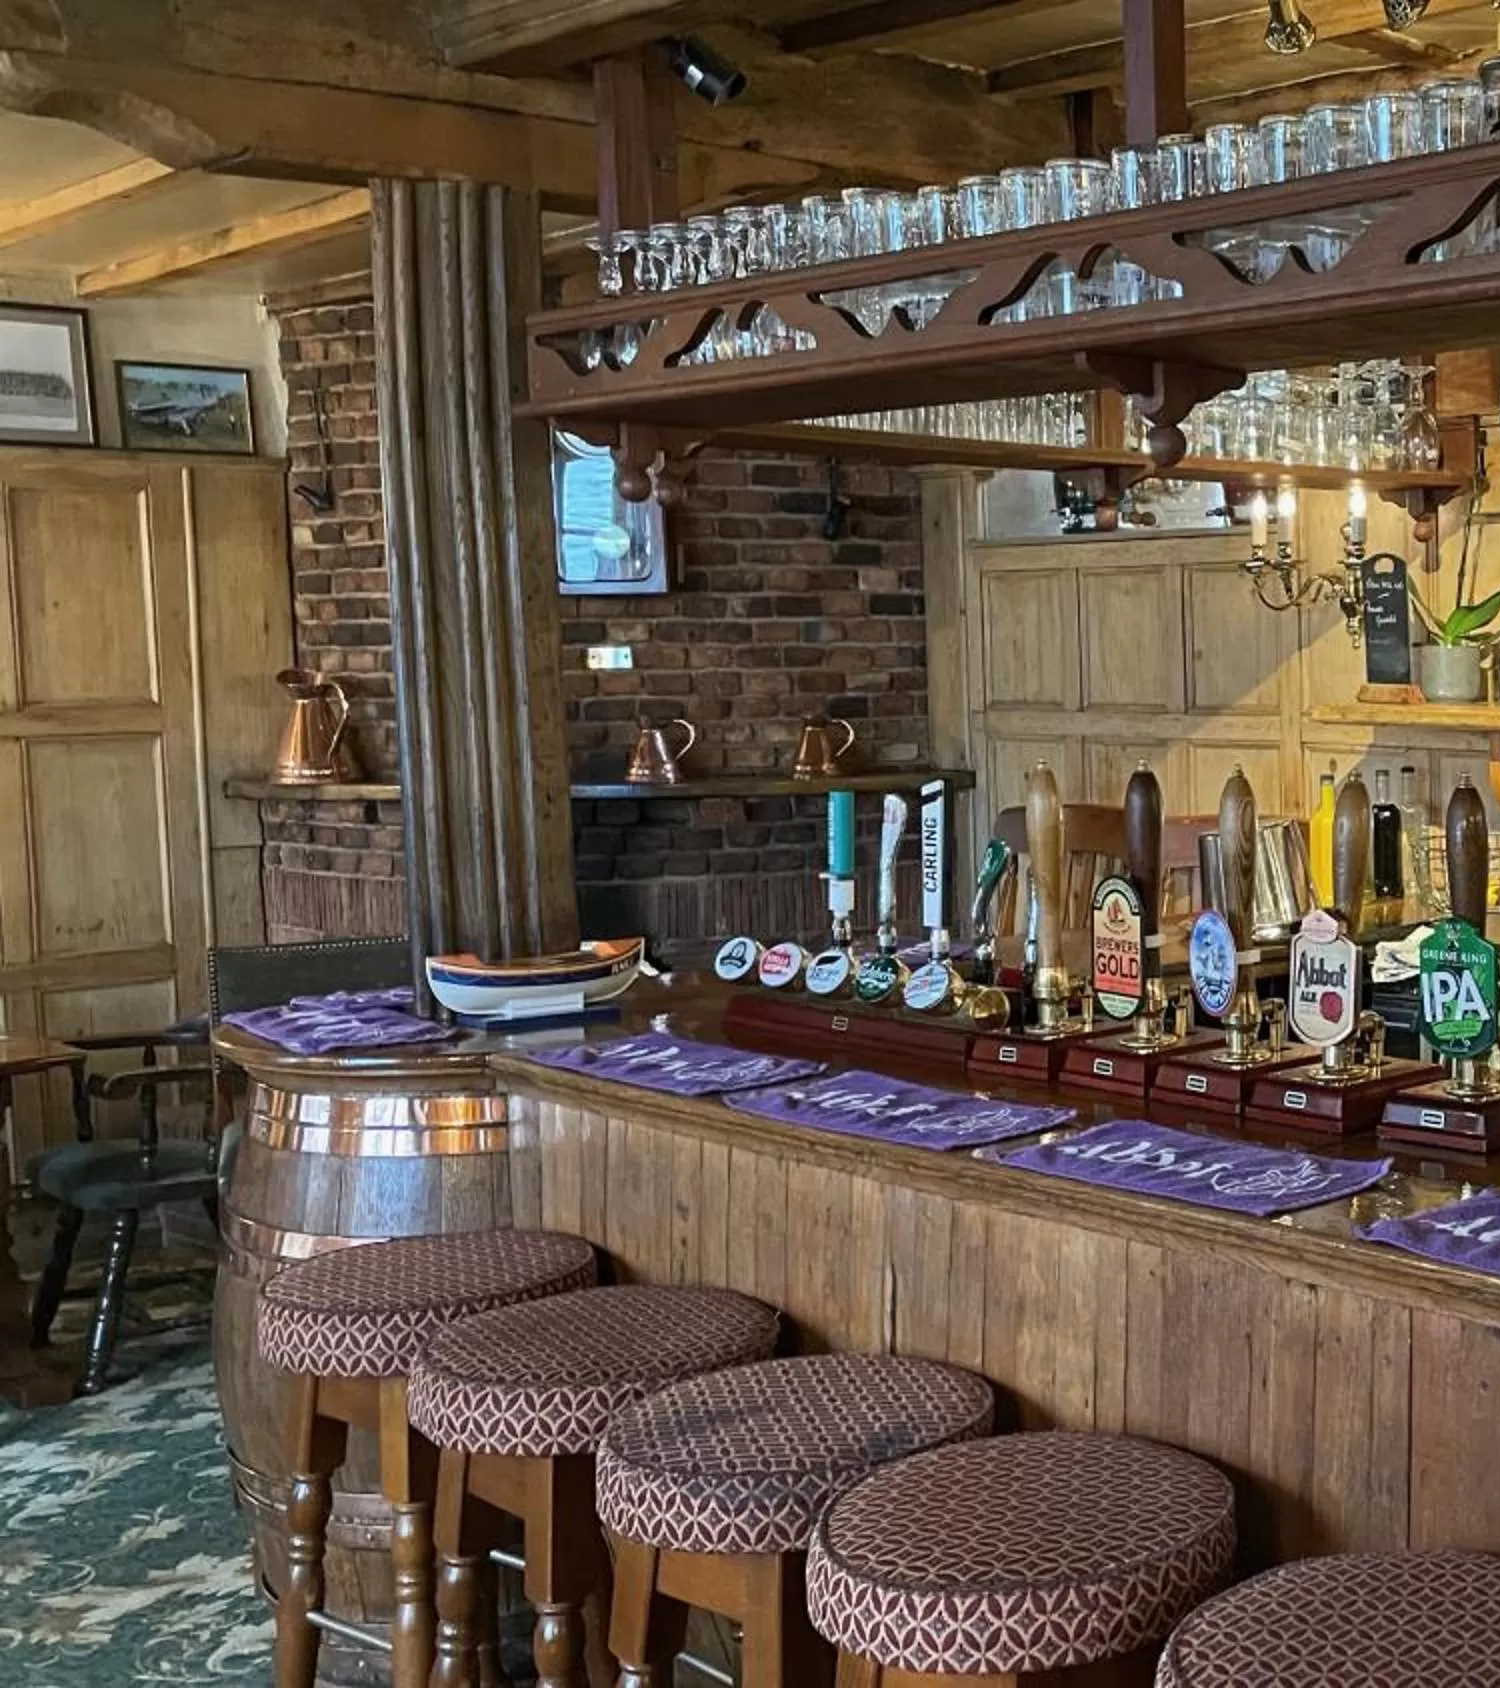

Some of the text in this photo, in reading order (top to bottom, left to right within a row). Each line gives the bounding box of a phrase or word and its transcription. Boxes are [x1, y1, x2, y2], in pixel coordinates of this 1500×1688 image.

[924, 817, 938, 893] CARLING
[1096, 953, 1139, 978] GOLD
[1296, 950, 1347, 988] Abbot
[1421, 969, 1490, 1023] IPA
